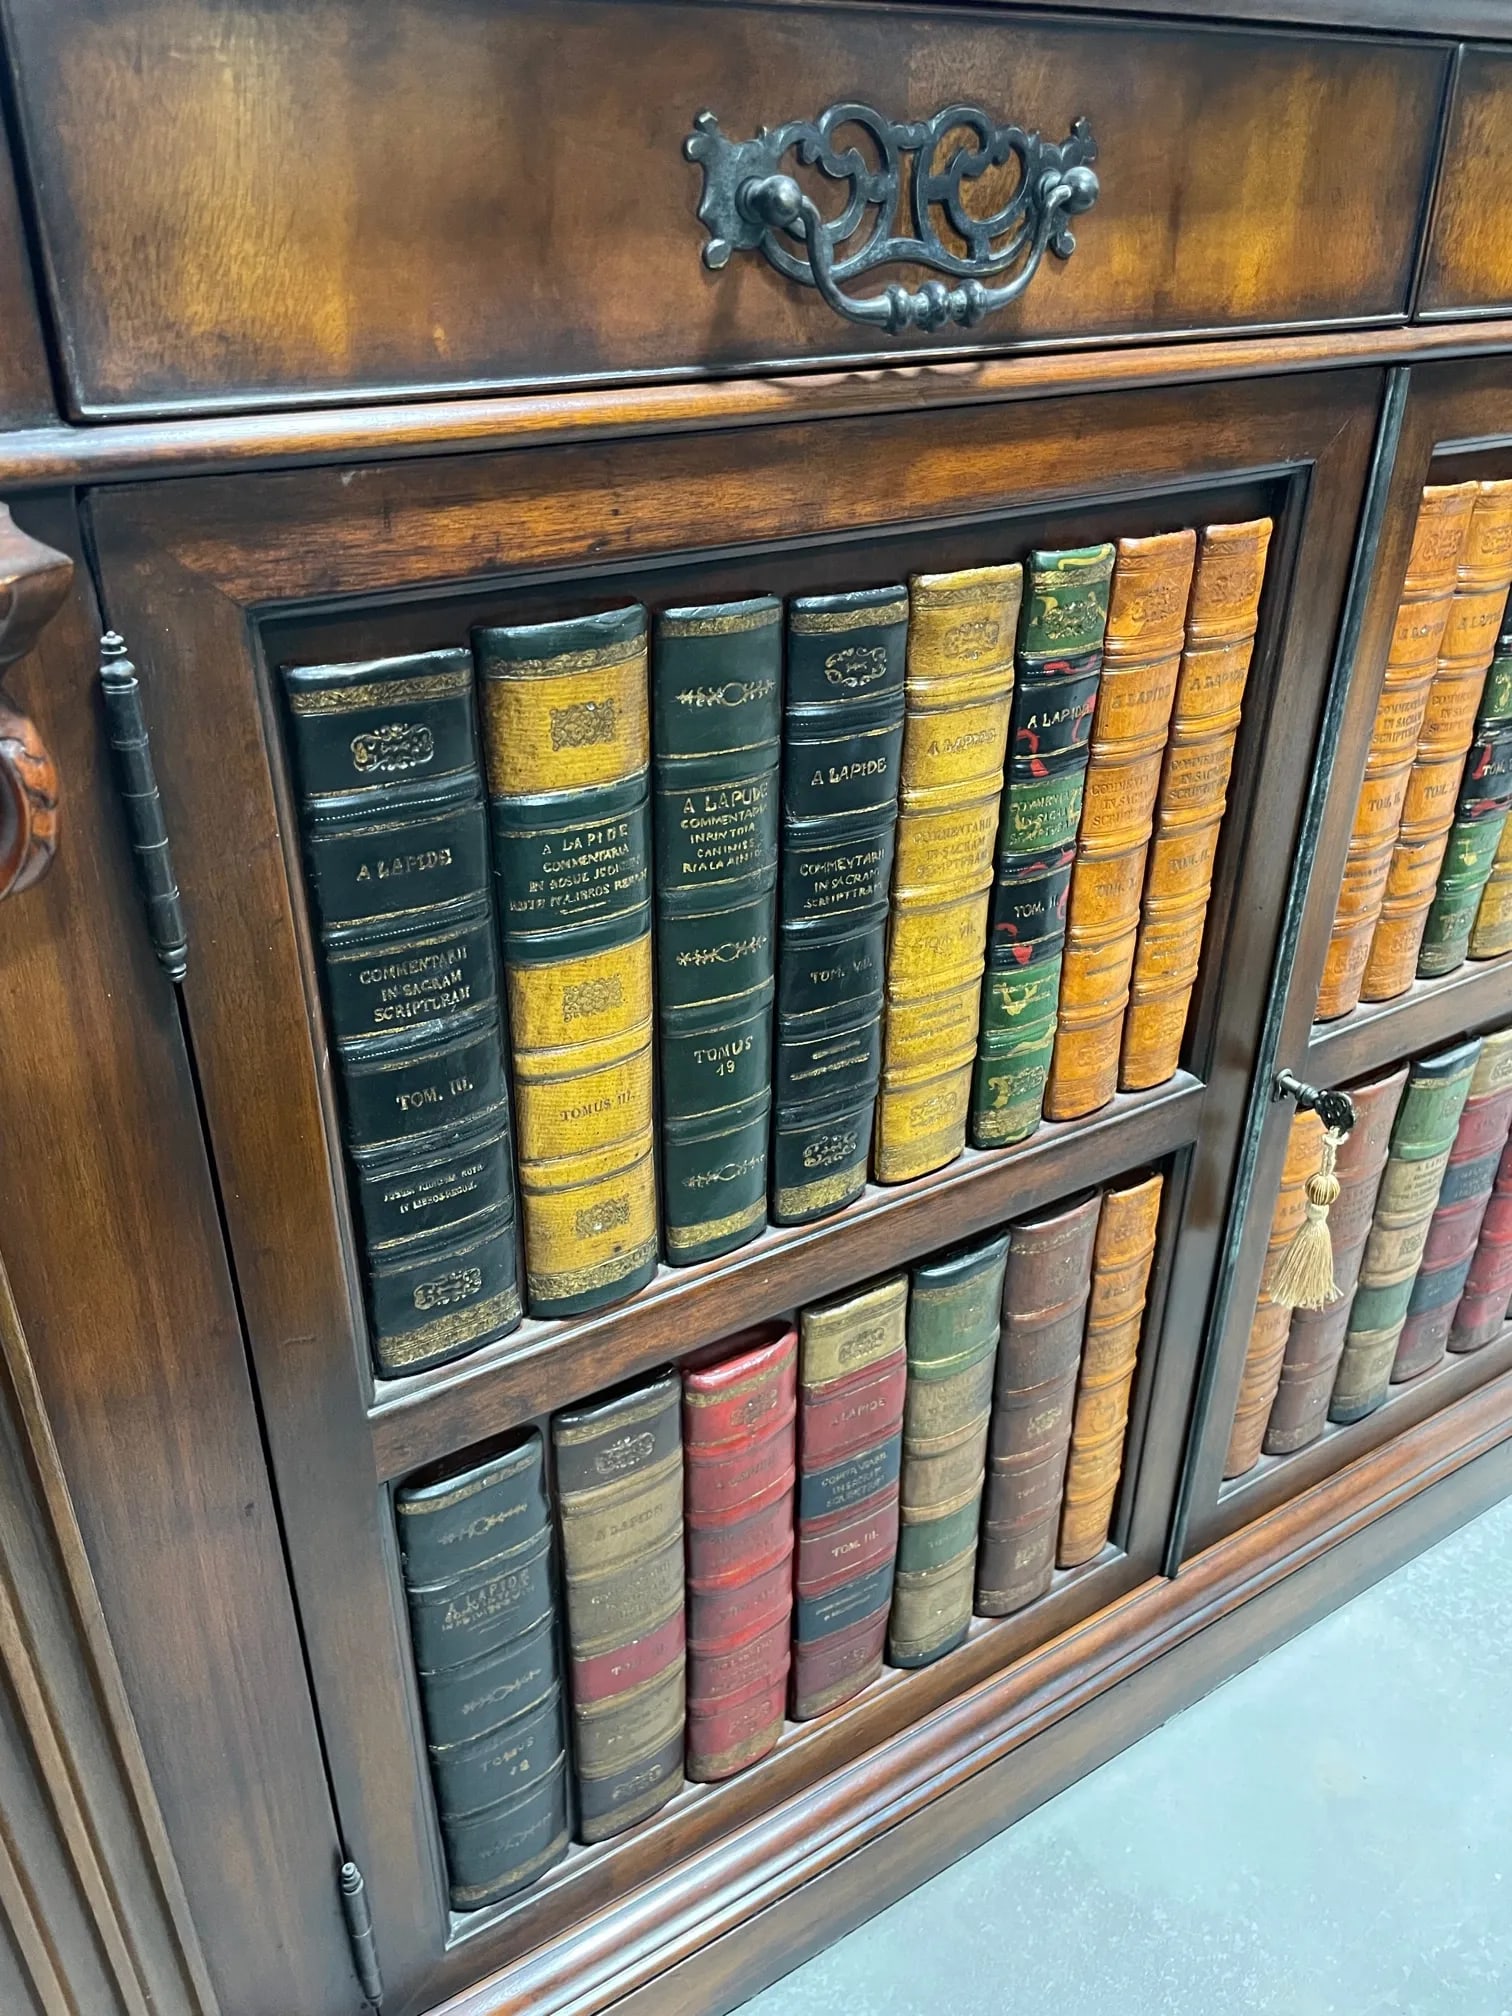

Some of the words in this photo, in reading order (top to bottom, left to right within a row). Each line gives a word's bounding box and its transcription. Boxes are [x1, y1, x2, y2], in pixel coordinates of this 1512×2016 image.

[1027, 714, 1038, 730] A
[927, 741, 940, 757] A
[811, 770, 824, 786] A
[829, 757, 888, 784] LAPIDE
[683, 797, 696, 814] A
[541, 844, 552, 856] A
[356, 866, 371, 882] A
[814, 879, 830, 894] IN
[831, 866, 881, 890] SACRAM
[1014, 899, 1045, 919] TOM.
[359, 946, 468, 985] COMMENTARII
[381, 985, 397, 1002] IN
[402, 968, 463, 997] SACRAM
[694, 1036, 754, 1065] TOMUS
[715, 1060, 736, 1077] 19
[396, 1087, 444, 1111] TOM.
[559, 1098, 611, 1122] TOMUS
